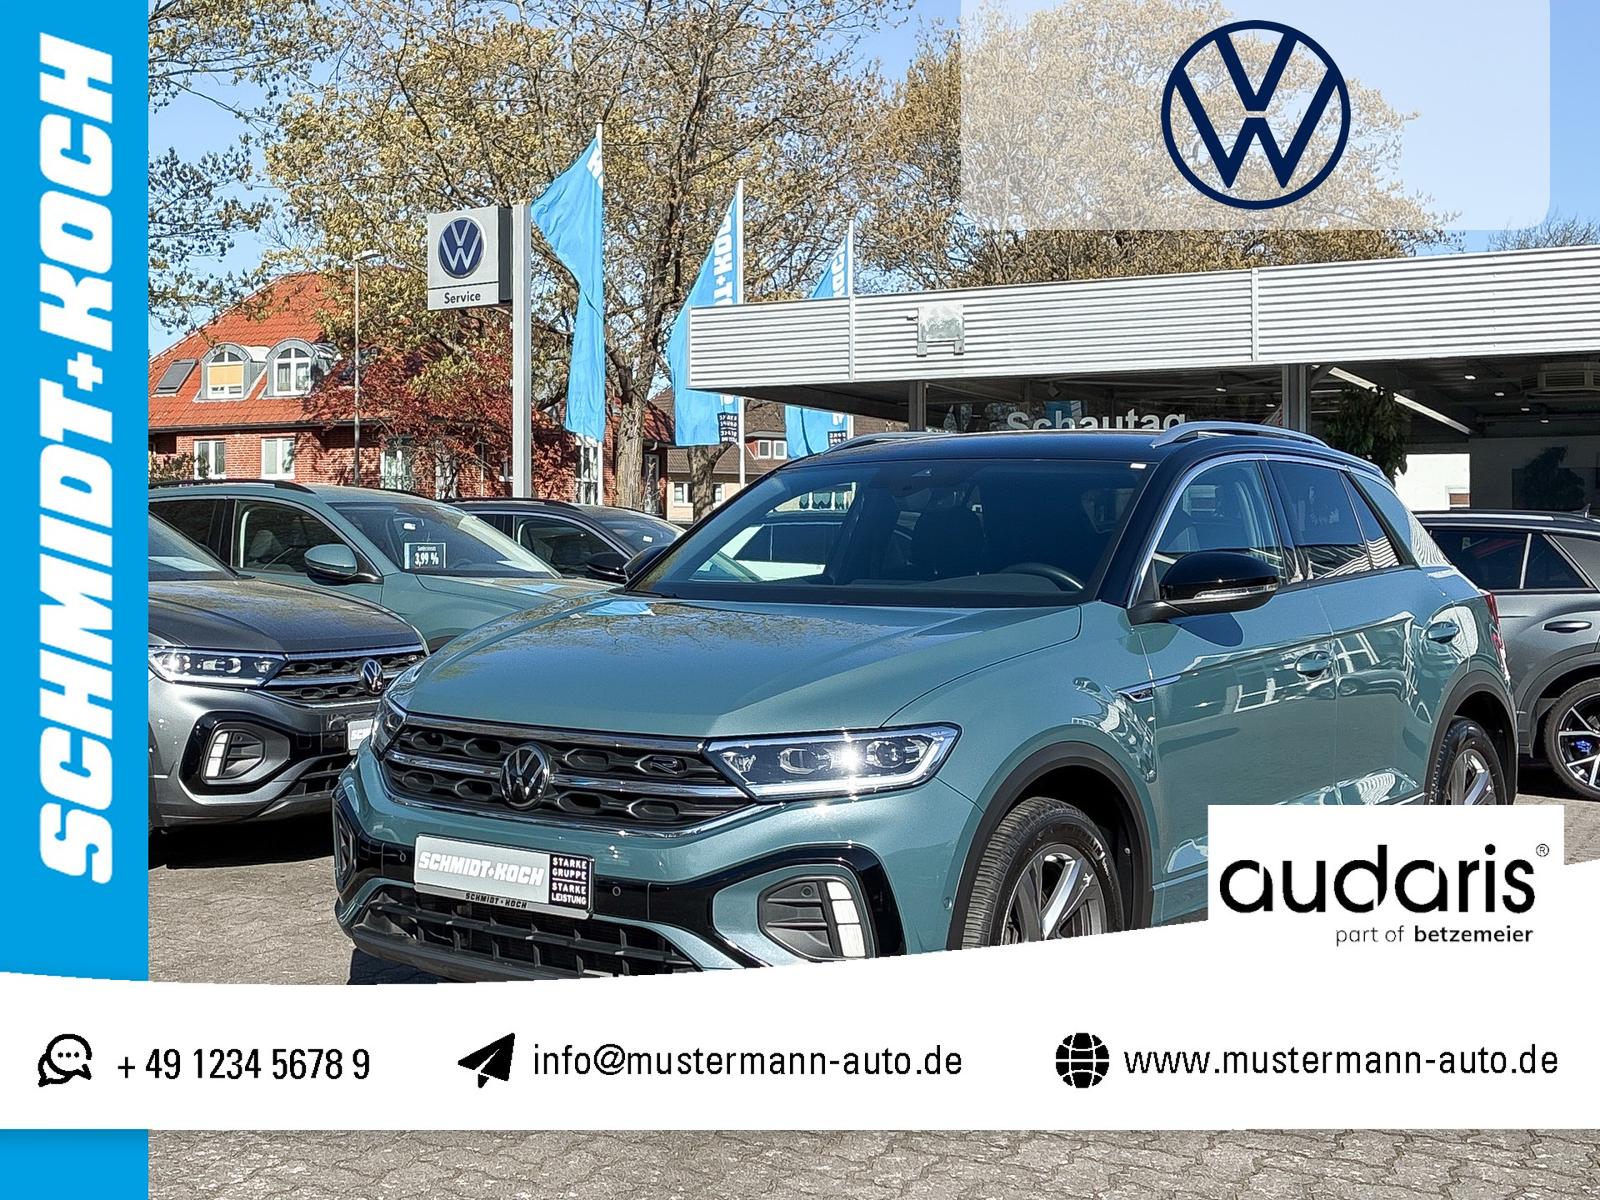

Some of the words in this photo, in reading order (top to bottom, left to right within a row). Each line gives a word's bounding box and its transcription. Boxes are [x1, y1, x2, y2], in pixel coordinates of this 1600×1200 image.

[444, 291, 481, 304] Service
[414, 552, 429, 567] 3,99
[552, 856, 588, 870] STARKE
[552, 869, 587, 881] GRUPPE
[551, 882, 587, 895] STARKE
[551, 892, 587, 906] LEISTUNG
